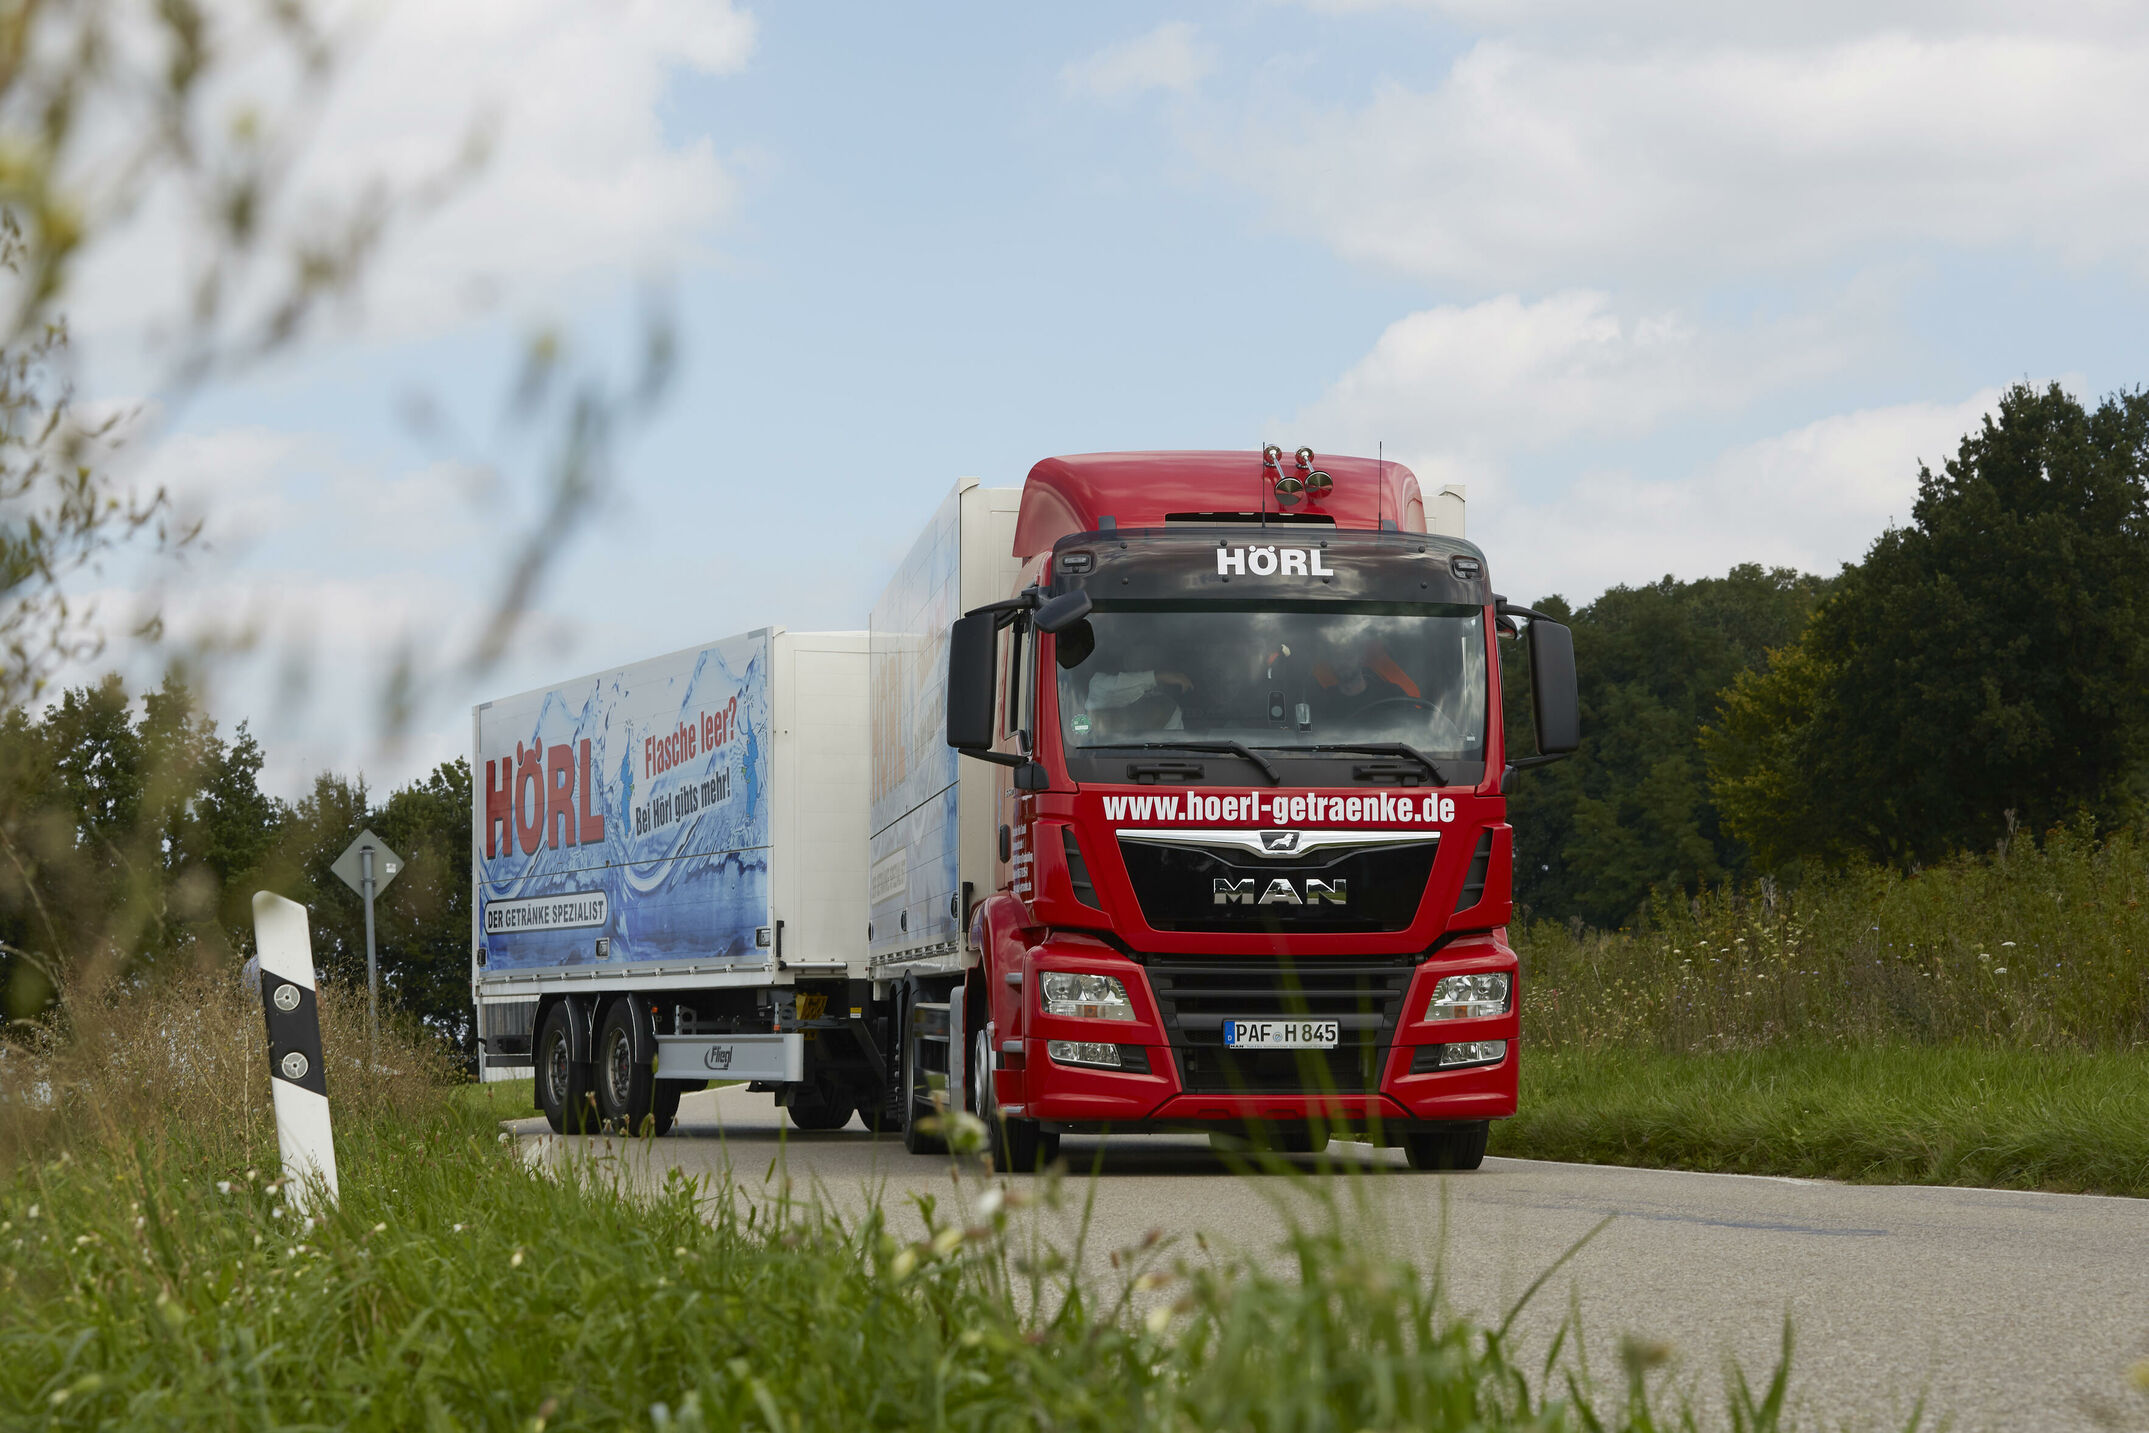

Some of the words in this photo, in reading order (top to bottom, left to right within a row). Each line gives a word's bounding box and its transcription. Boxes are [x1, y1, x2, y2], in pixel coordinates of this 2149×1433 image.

[1217, 545, 1334, 576] HÖRL
[645, 721, 697, 780] Flasche
[700, 696, 737, 754] leer?
[486, 737, 605, 860] HÖRL
[635, 802, 651, 836] Bei
[653, 792, 673, 829] Hörl
[675, 784, 699, 823] gibts
[701, 766, 731, 808] mehr!
[1103, 791, 1456, 824] www.hoerl-getraenke.de
[1213, 878, 1347, 905] MAN
[488, 910, 504, 929] DER
[505, 904, 550, 928] GETRÄNKE
[552, 900, 604, 924] SPEZIALIST
[1235, 1024, 1272, 1042] PAF
[1285, 1024, 1297, 1042] H
[1302, 1024, 1336, 1042] 845
[710, 1045, 734, 1068] Fliegl
